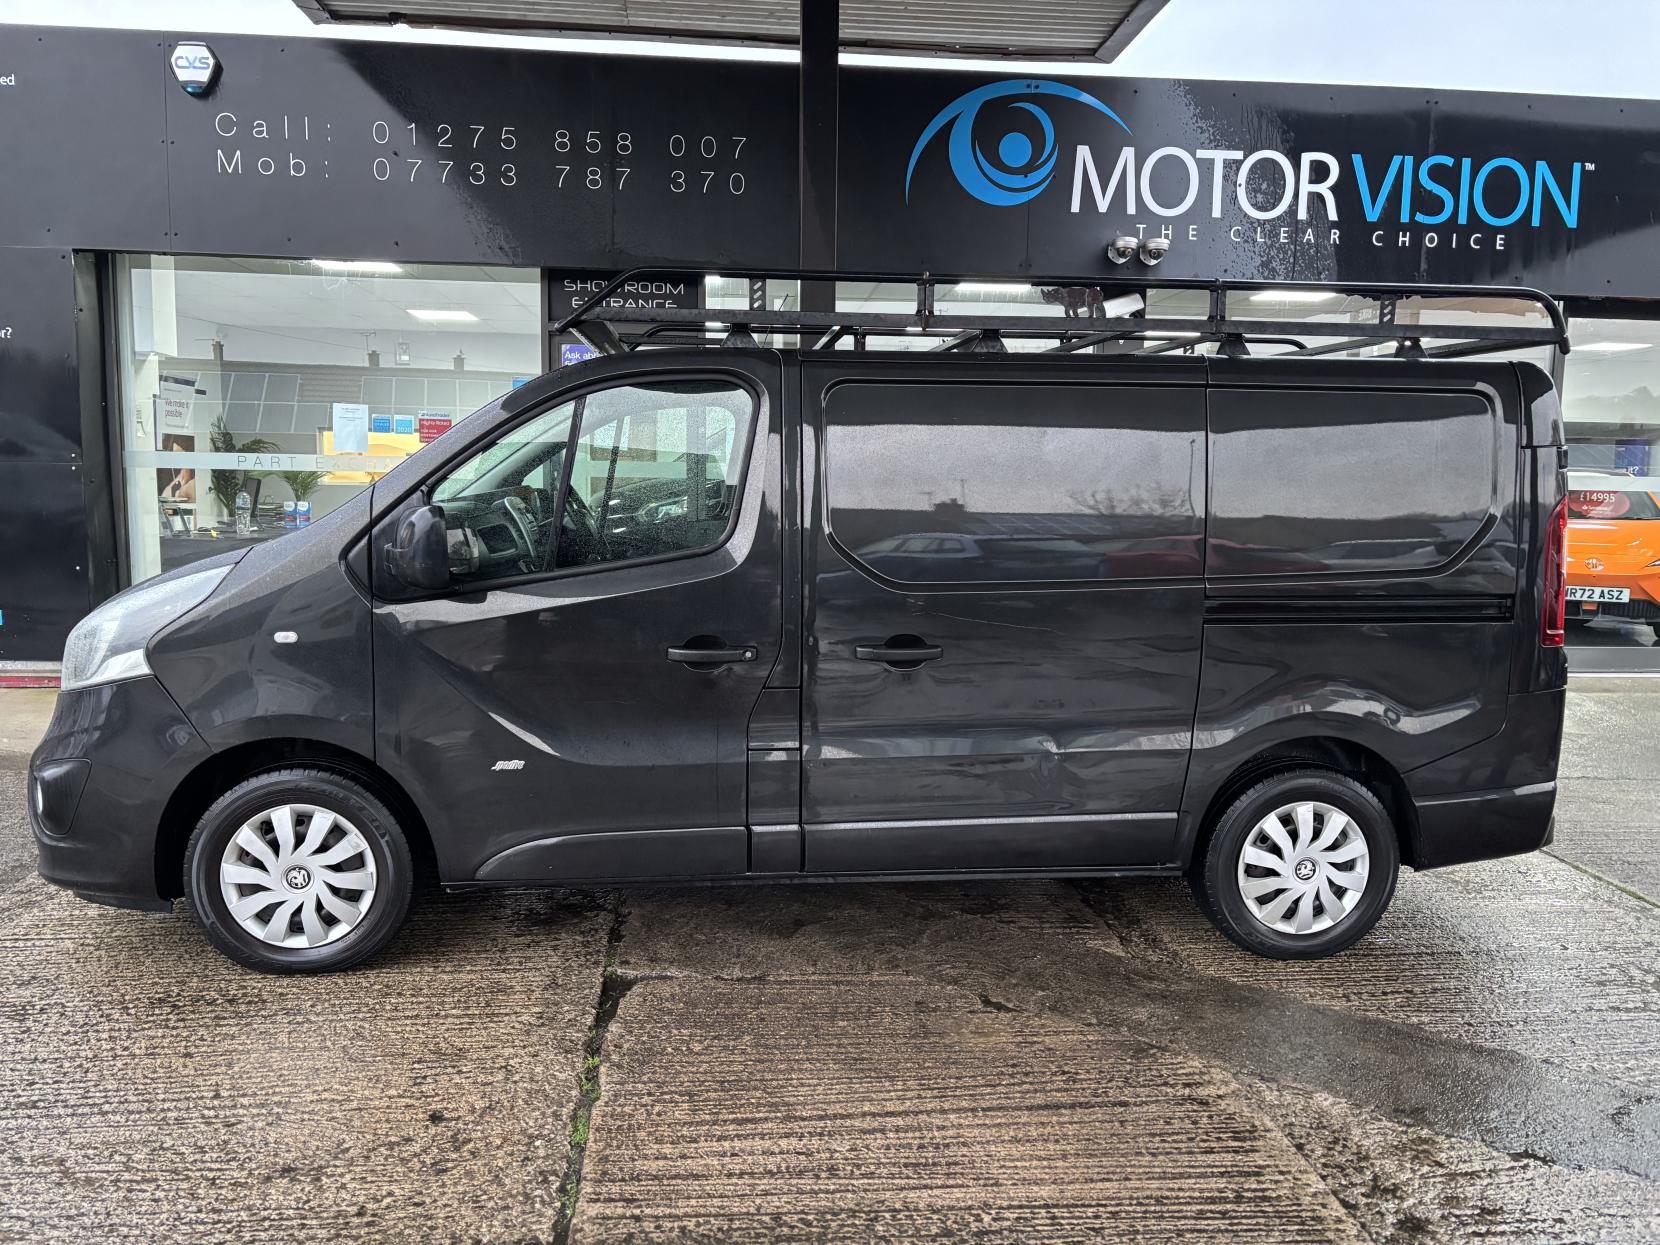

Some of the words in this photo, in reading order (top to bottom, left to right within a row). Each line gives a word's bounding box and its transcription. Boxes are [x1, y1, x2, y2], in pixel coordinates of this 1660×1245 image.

[215, 112, 331, 142] Call:
[372, 121, 517, 150] 01275
[554, 130, 632, 155] 858
[669, 135, 747, 159] 007
[216, 149, 329, 178] Mob:
[373, 158, 517, 186] 07733
[555, 166, 631, 190] 787
[670, 170, 745, 194] 370
[1070, 144, 1340, 221] MOTOR
[1351, 154, 1582, 229] VISION
[1136, 224, 1197, 241] THE
[1230, 226, 1340, 245] CLEAR
[1372, 231, 1506, 250] CHOICE
[572, 297, 677, 308] ETRANCE
[564, 351, 581, 360] Ask
[237, 455, 297, 469] PART
[1598, 589, 1624, 601] ASZ
